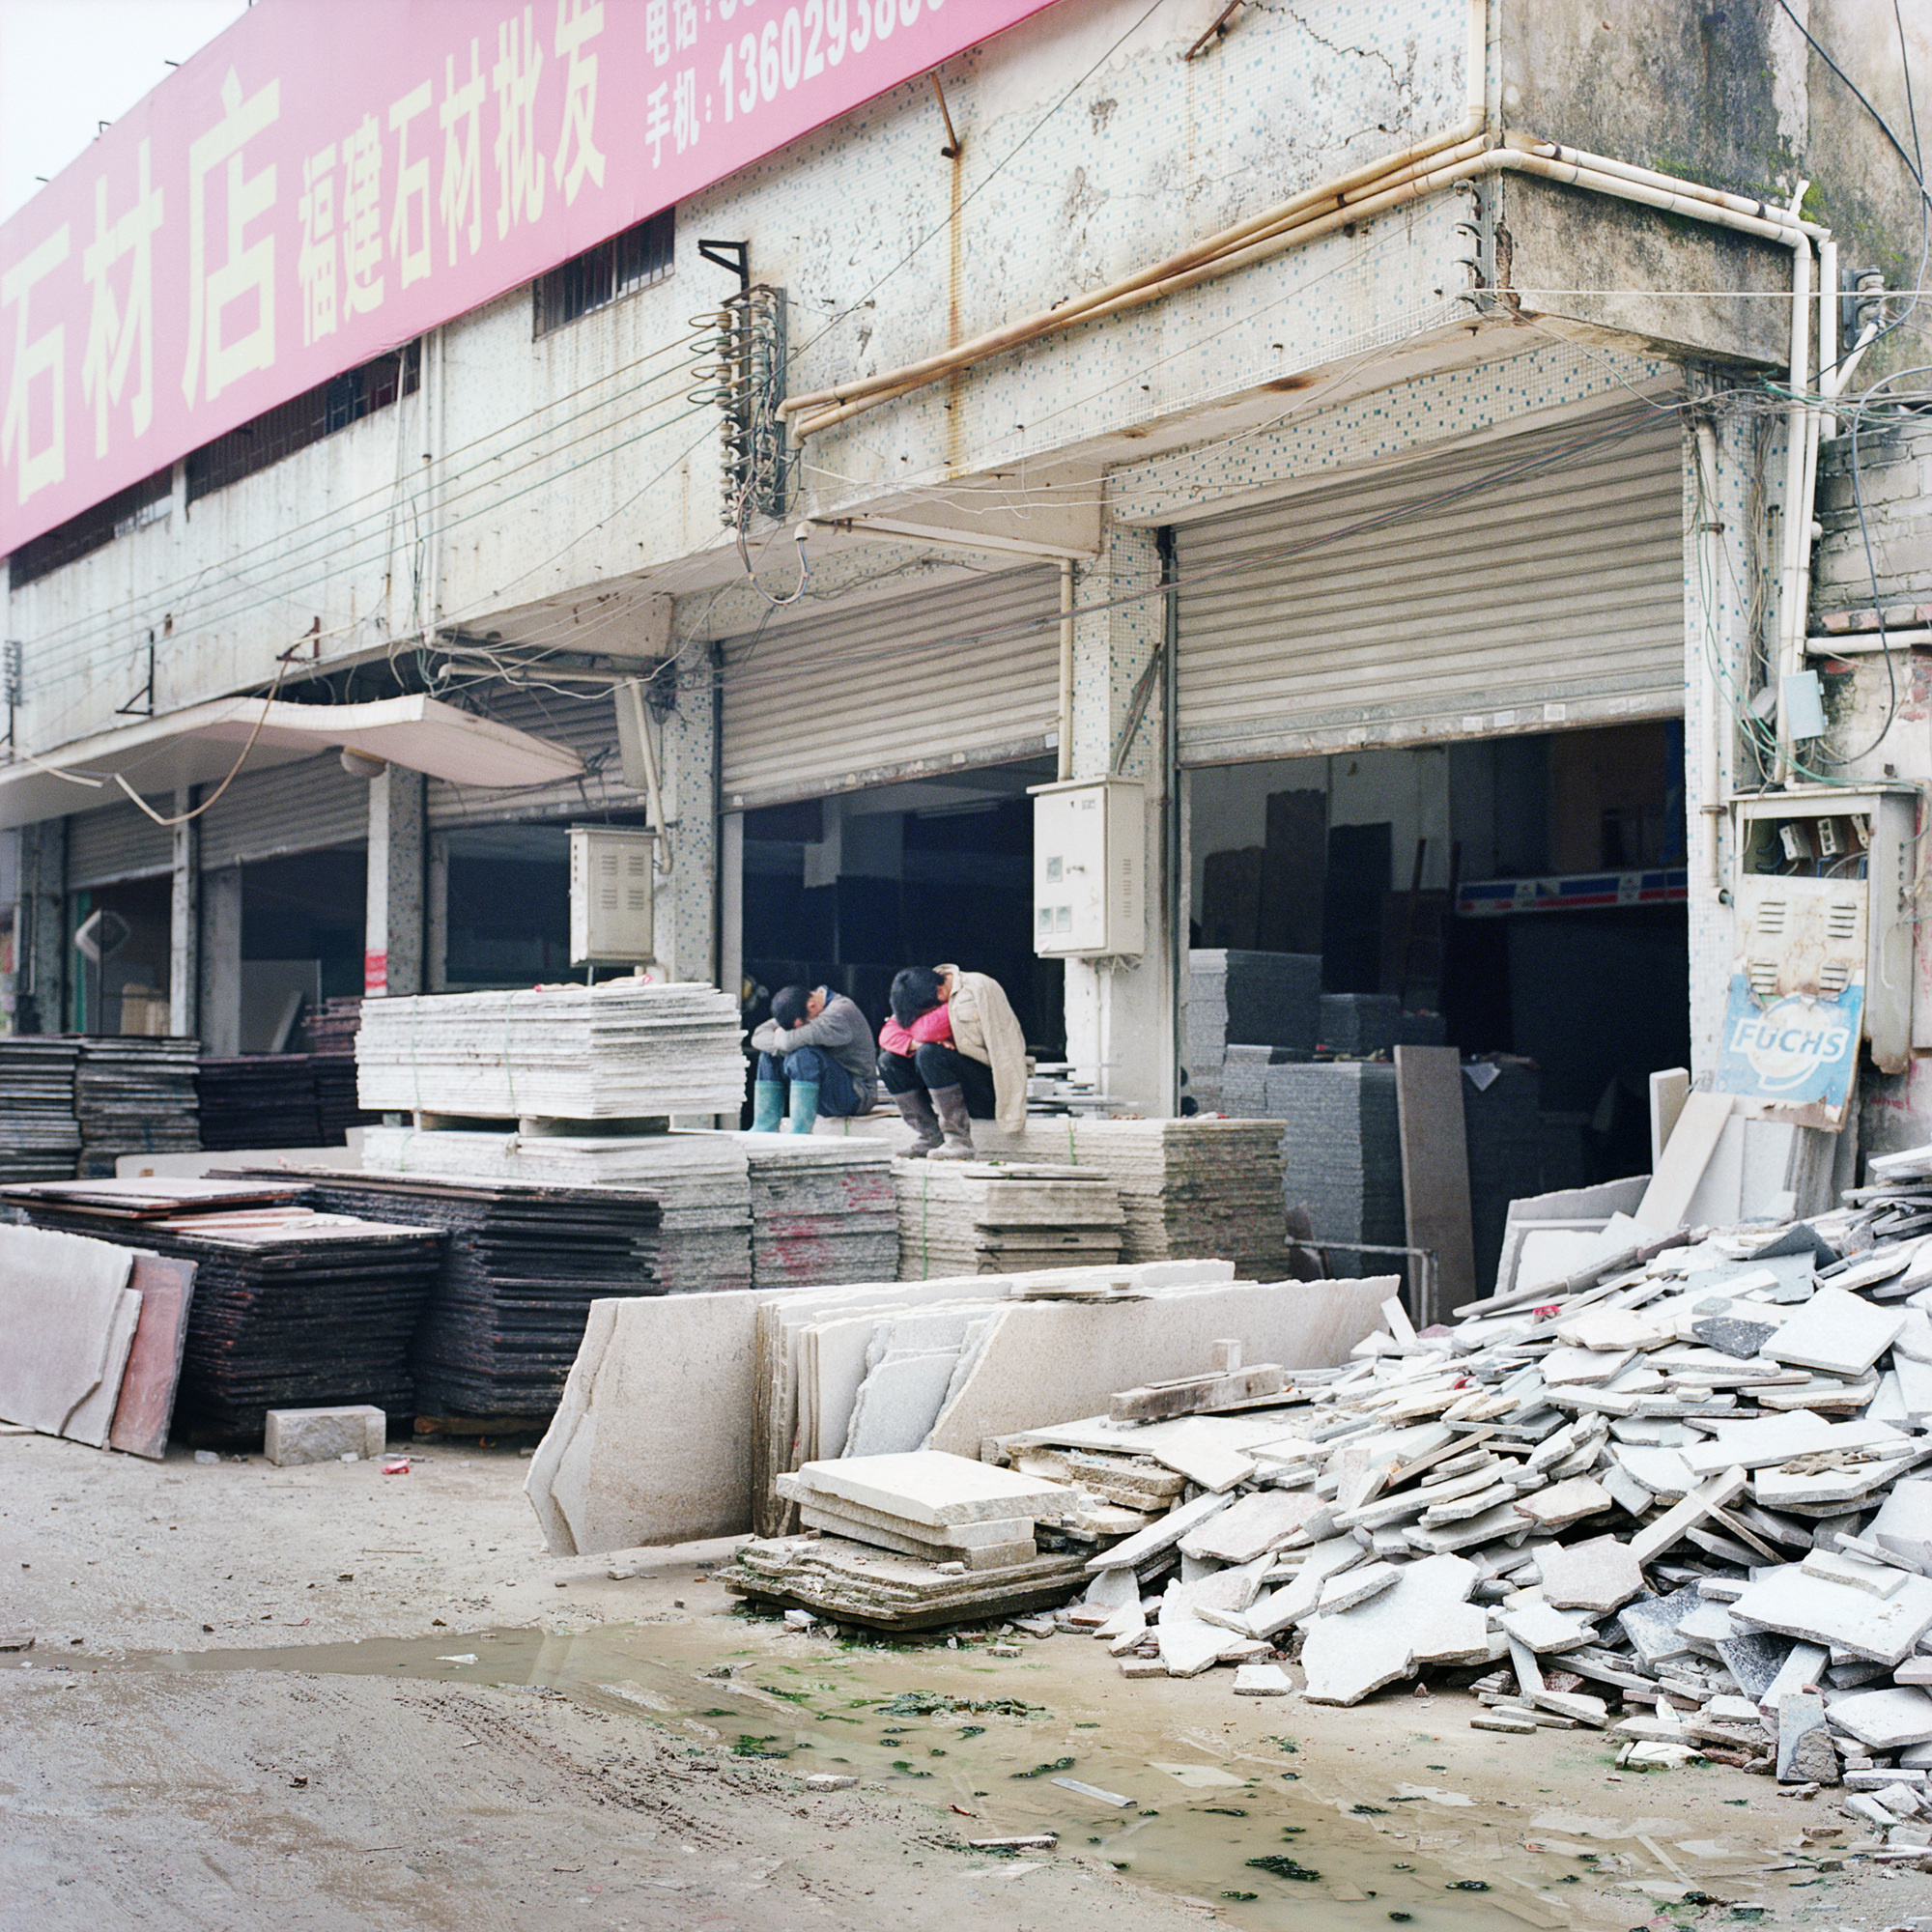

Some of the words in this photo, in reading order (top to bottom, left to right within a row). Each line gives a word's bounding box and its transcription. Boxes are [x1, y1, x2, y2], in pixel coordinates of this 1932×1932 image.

[0, 64, 280, 505] 石材店
[298, 0, 606, 348] 福建石材批发
[1735, 1024, 1845, 1057] FUCHS
